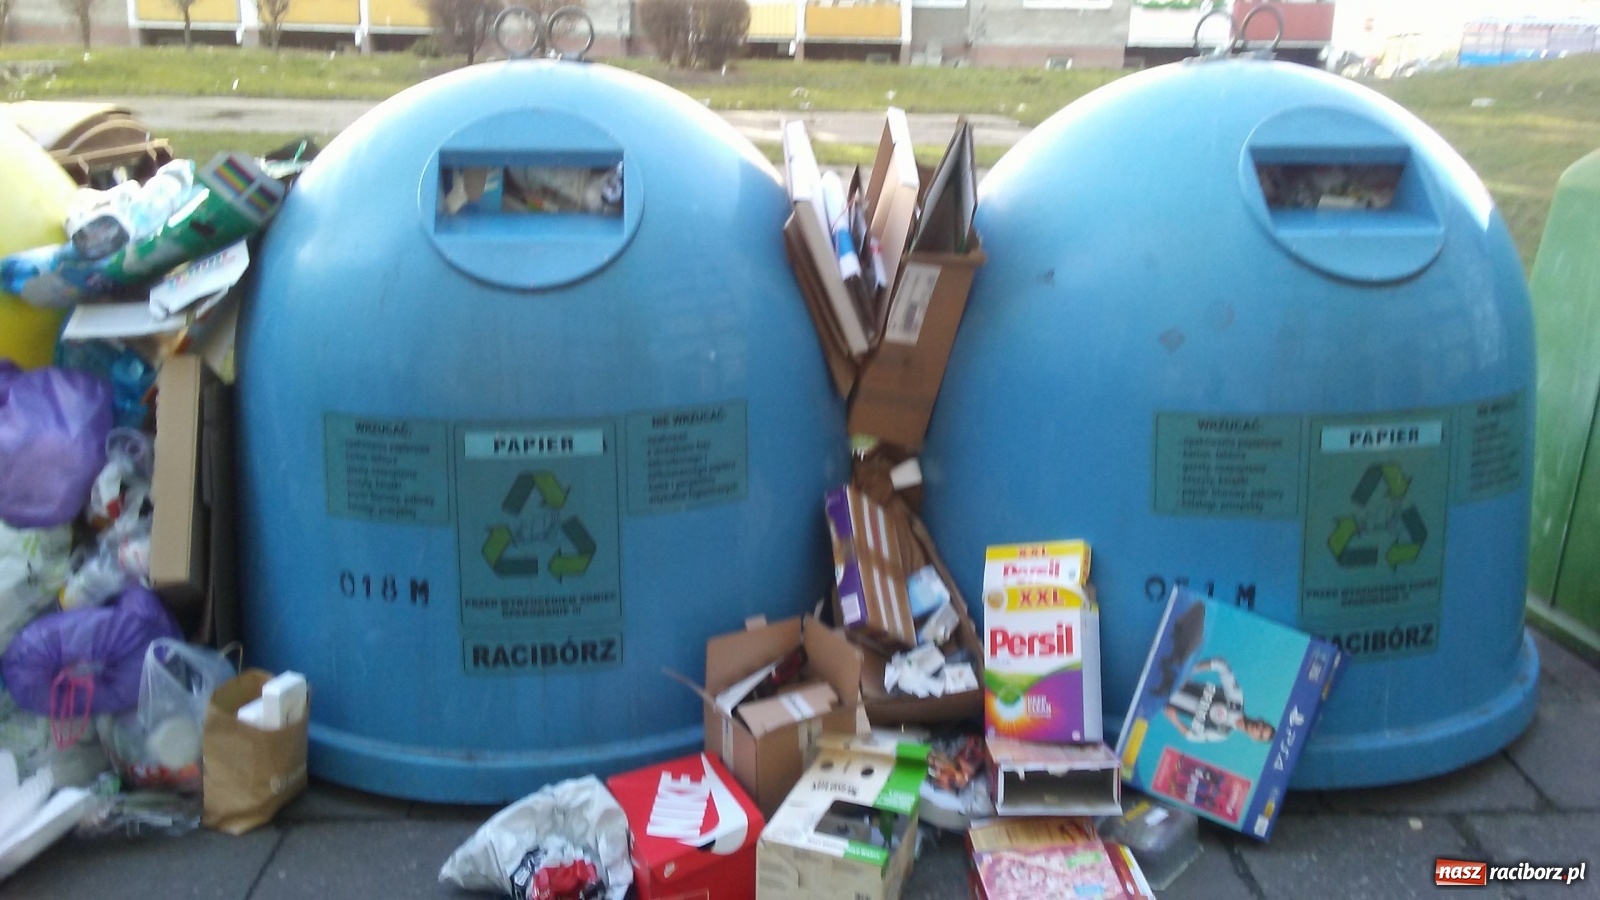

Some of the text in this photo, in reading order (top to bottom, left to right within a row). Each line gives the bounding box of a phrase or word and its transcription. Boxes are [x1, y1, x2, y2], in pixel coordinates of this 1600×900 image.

[652, 415, 669, 429] NIE
[1350, 428, 1418, 446] PAPIER
[493, 437, 573, 454] PAPIER
[1019, 587, 1065, 608] XXL
[472, 635, 617, 669] RACIBÓRZ
[989, 623, 1074, 659] Persil
[1318, 623, 1434, 656] ACIBÓRZ
[1274, 729, 1297, 771] PS4
[646, 770, 711, 838] NIKE
